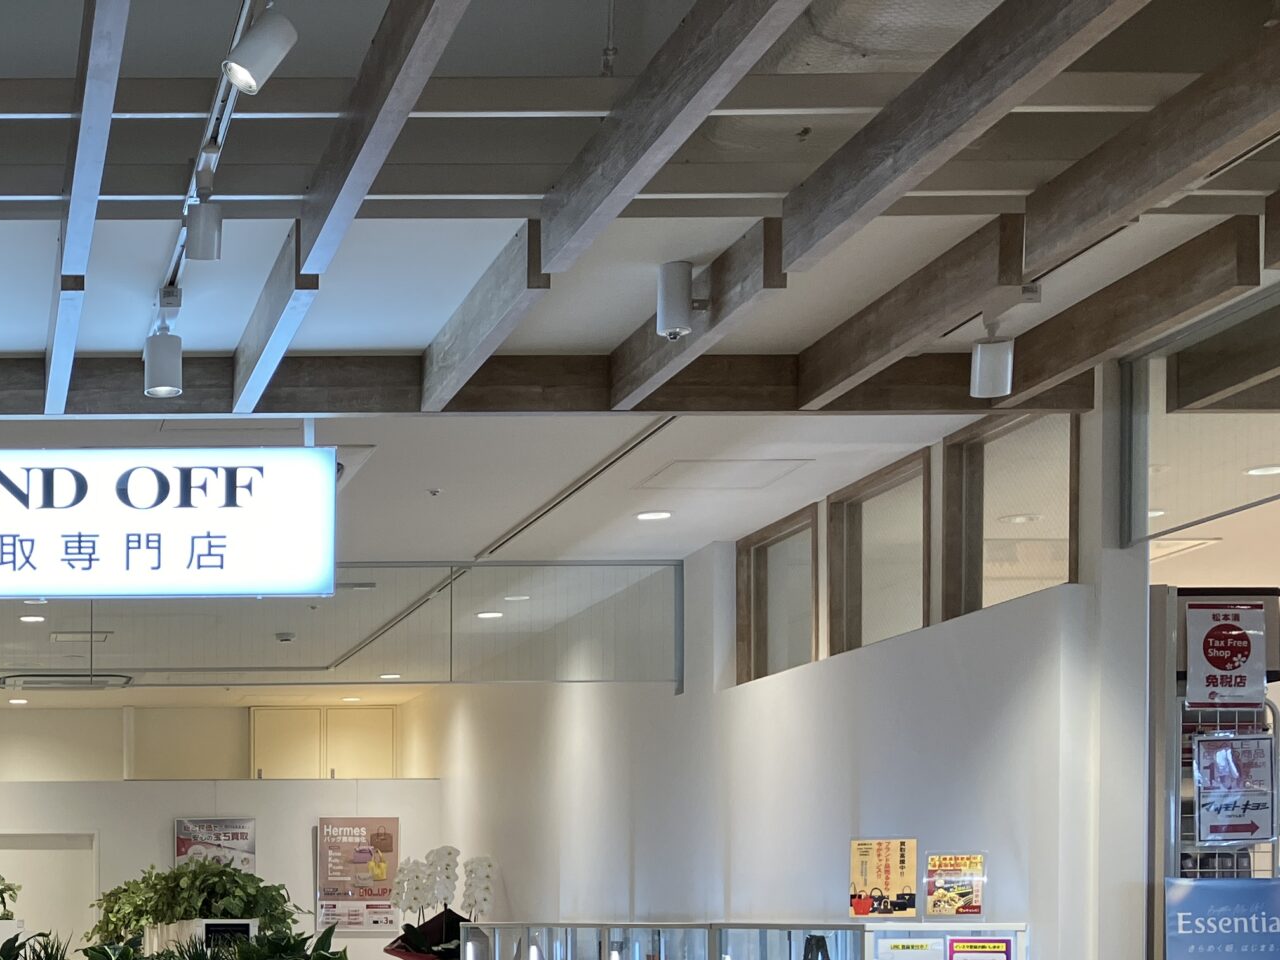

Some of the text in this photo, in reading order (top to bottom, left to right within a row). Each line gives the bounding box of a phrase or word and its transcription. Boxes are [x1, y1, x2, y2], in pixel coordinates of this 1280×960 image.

[115, 466, 265, 510] OFF
[1208, 638, 1249, 647] Tax Free
[1208, 648, 1231, 659] Shop
[1205, 674, 1247, 688] 免税店
[323, 825, 368, 836] Hermes
[1177, 911, 1280, 934] Essentia
